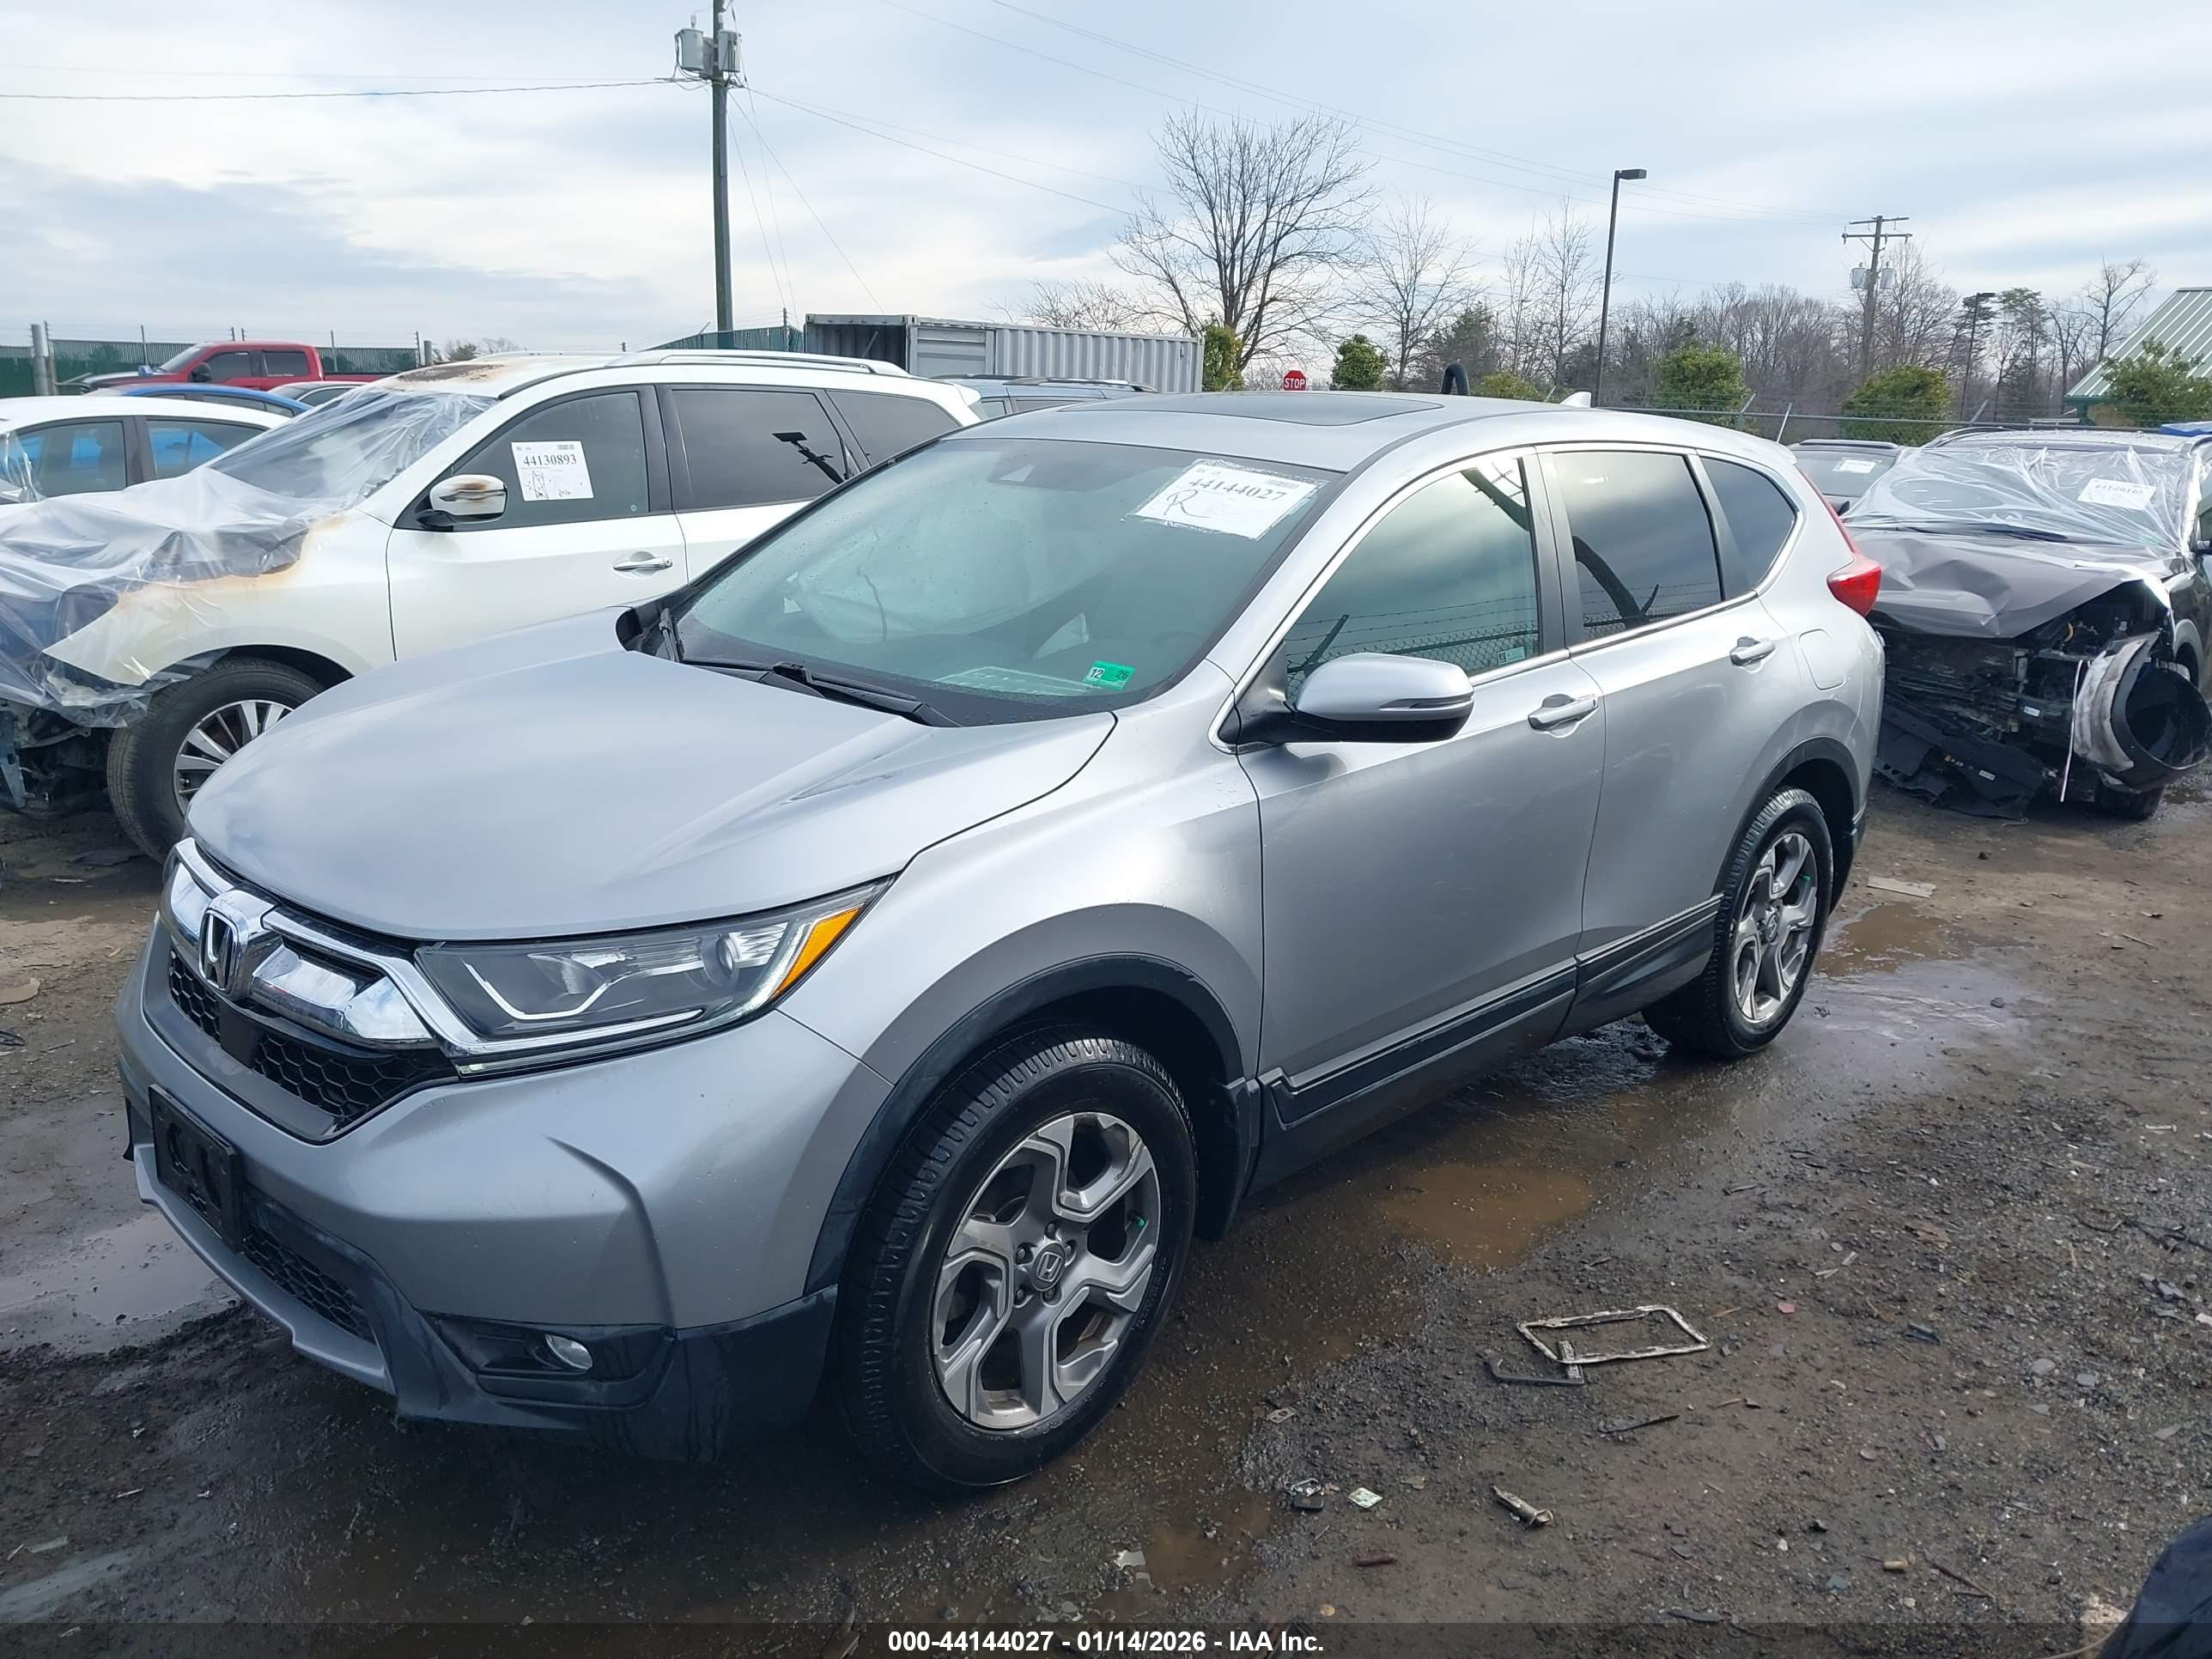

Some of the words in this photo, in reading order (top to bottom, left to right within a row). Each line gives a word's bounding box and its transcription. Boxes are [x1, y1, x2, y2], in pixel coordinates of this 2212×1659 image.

[1285, 378, 1305, 389] STOP
[523, 453, 577, 466] 44130893
[1188, 478, 1286, 501] 44144027
[1091, 669, 1103, 678] 12
